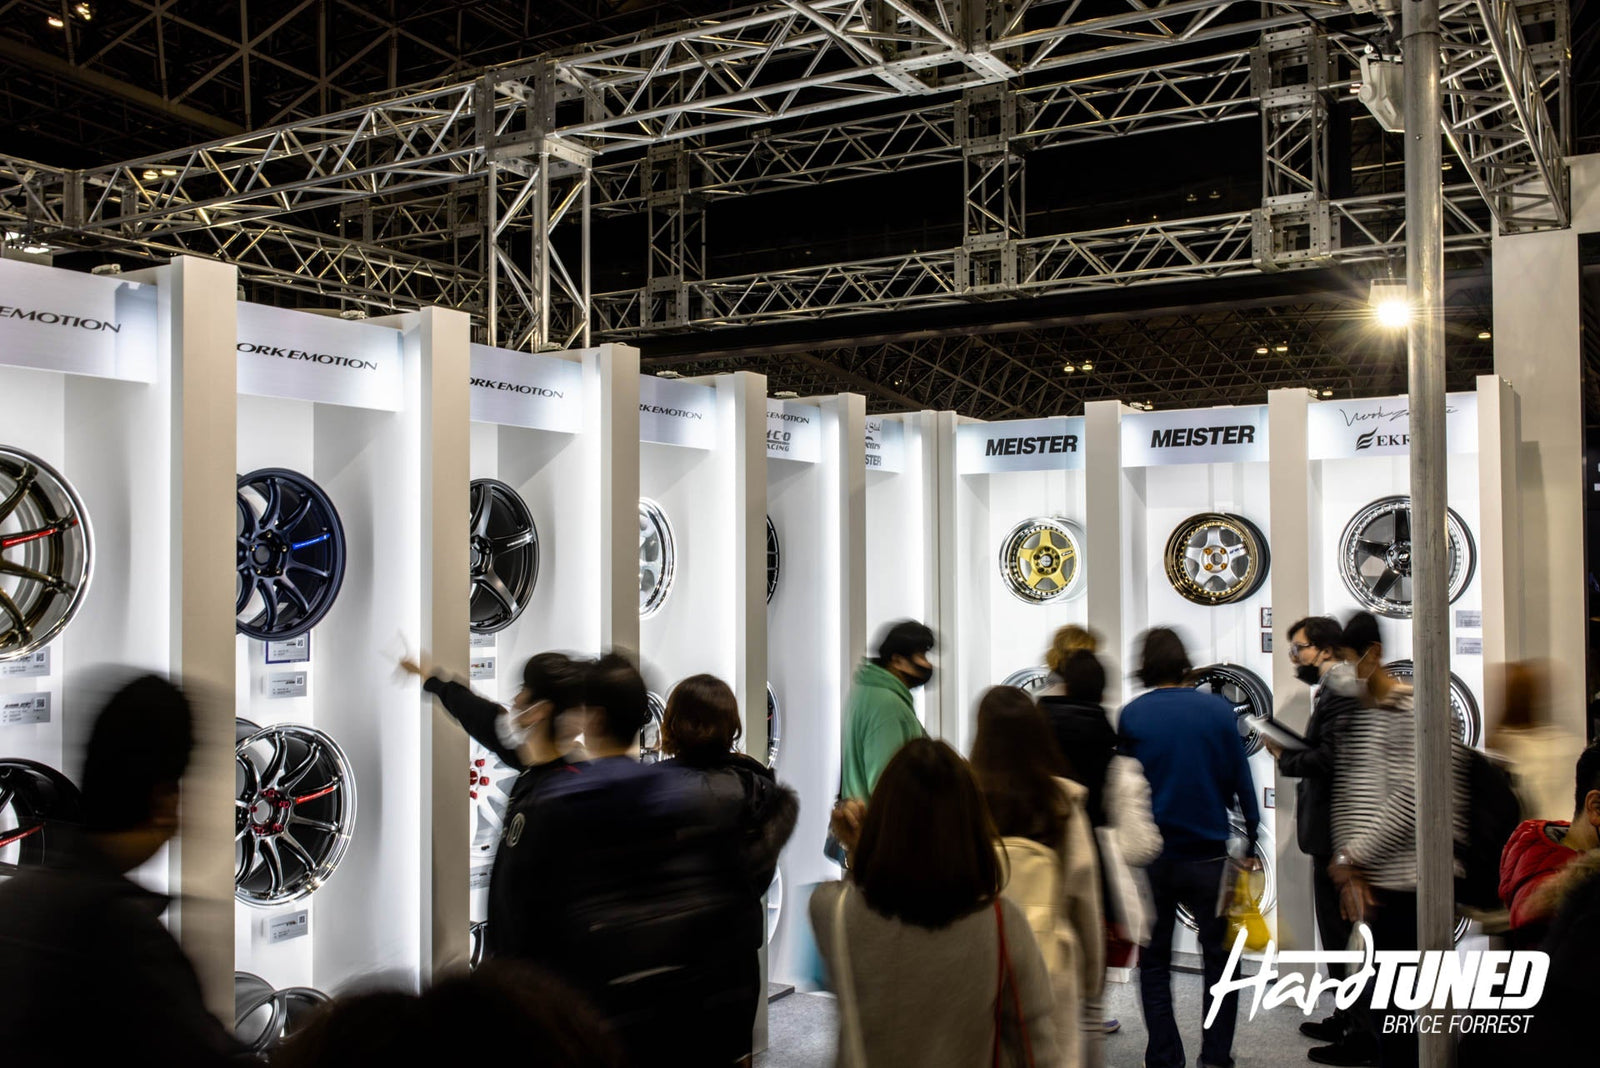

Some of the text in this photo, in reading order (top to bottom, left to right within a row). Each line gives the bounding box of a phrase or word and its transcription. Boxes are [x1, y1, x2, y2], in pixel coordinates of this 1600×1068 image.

[0, 305, 121, 333] EMOTION
[236, 342, 286, 358] ORK
[985, 434, 1078, 456] MEISTER
[1150, 425, 1255, 448] MEISTER
[1376, 434, 1410, 447] EKR
[865, 453, 882, 467] STER
